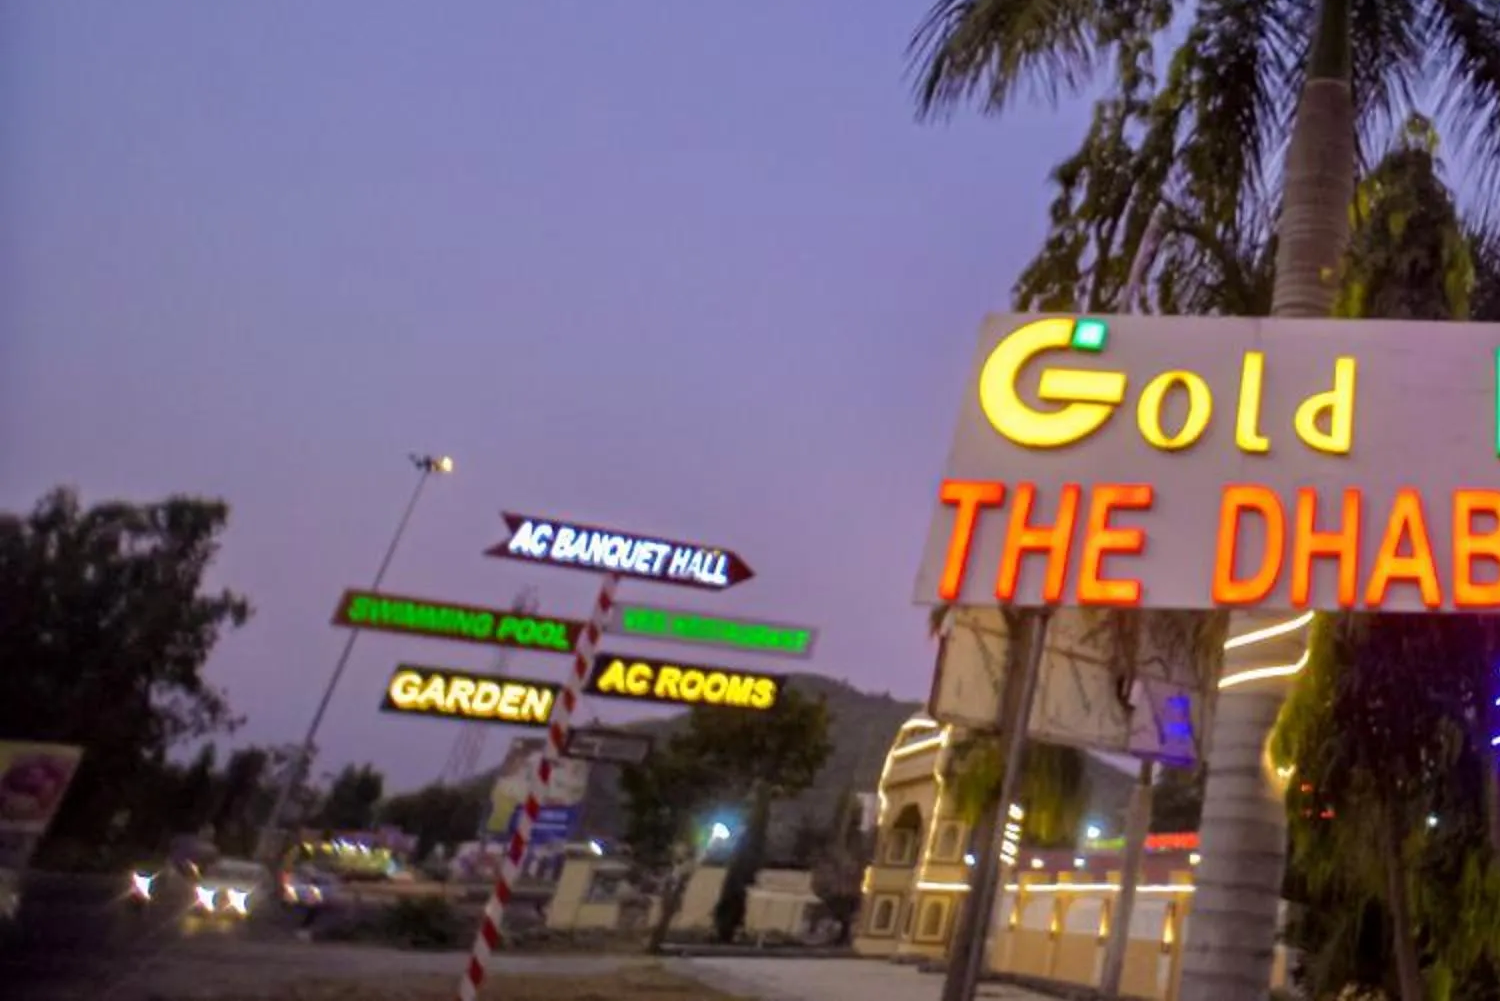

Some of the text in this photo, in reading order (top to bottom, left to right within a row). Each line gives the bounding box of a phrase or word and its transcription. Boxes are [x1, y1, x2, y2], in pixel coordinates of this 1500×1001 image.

[508, 521, 728, 586] AC BANQUET HALL
[937, 479, 1153, 607] THE
[348, 596, 571, 650] SWIMMING POOL
[389, 670, 554, 723] GARDEN
[598, 659, 776, 709] AC ROOMS
